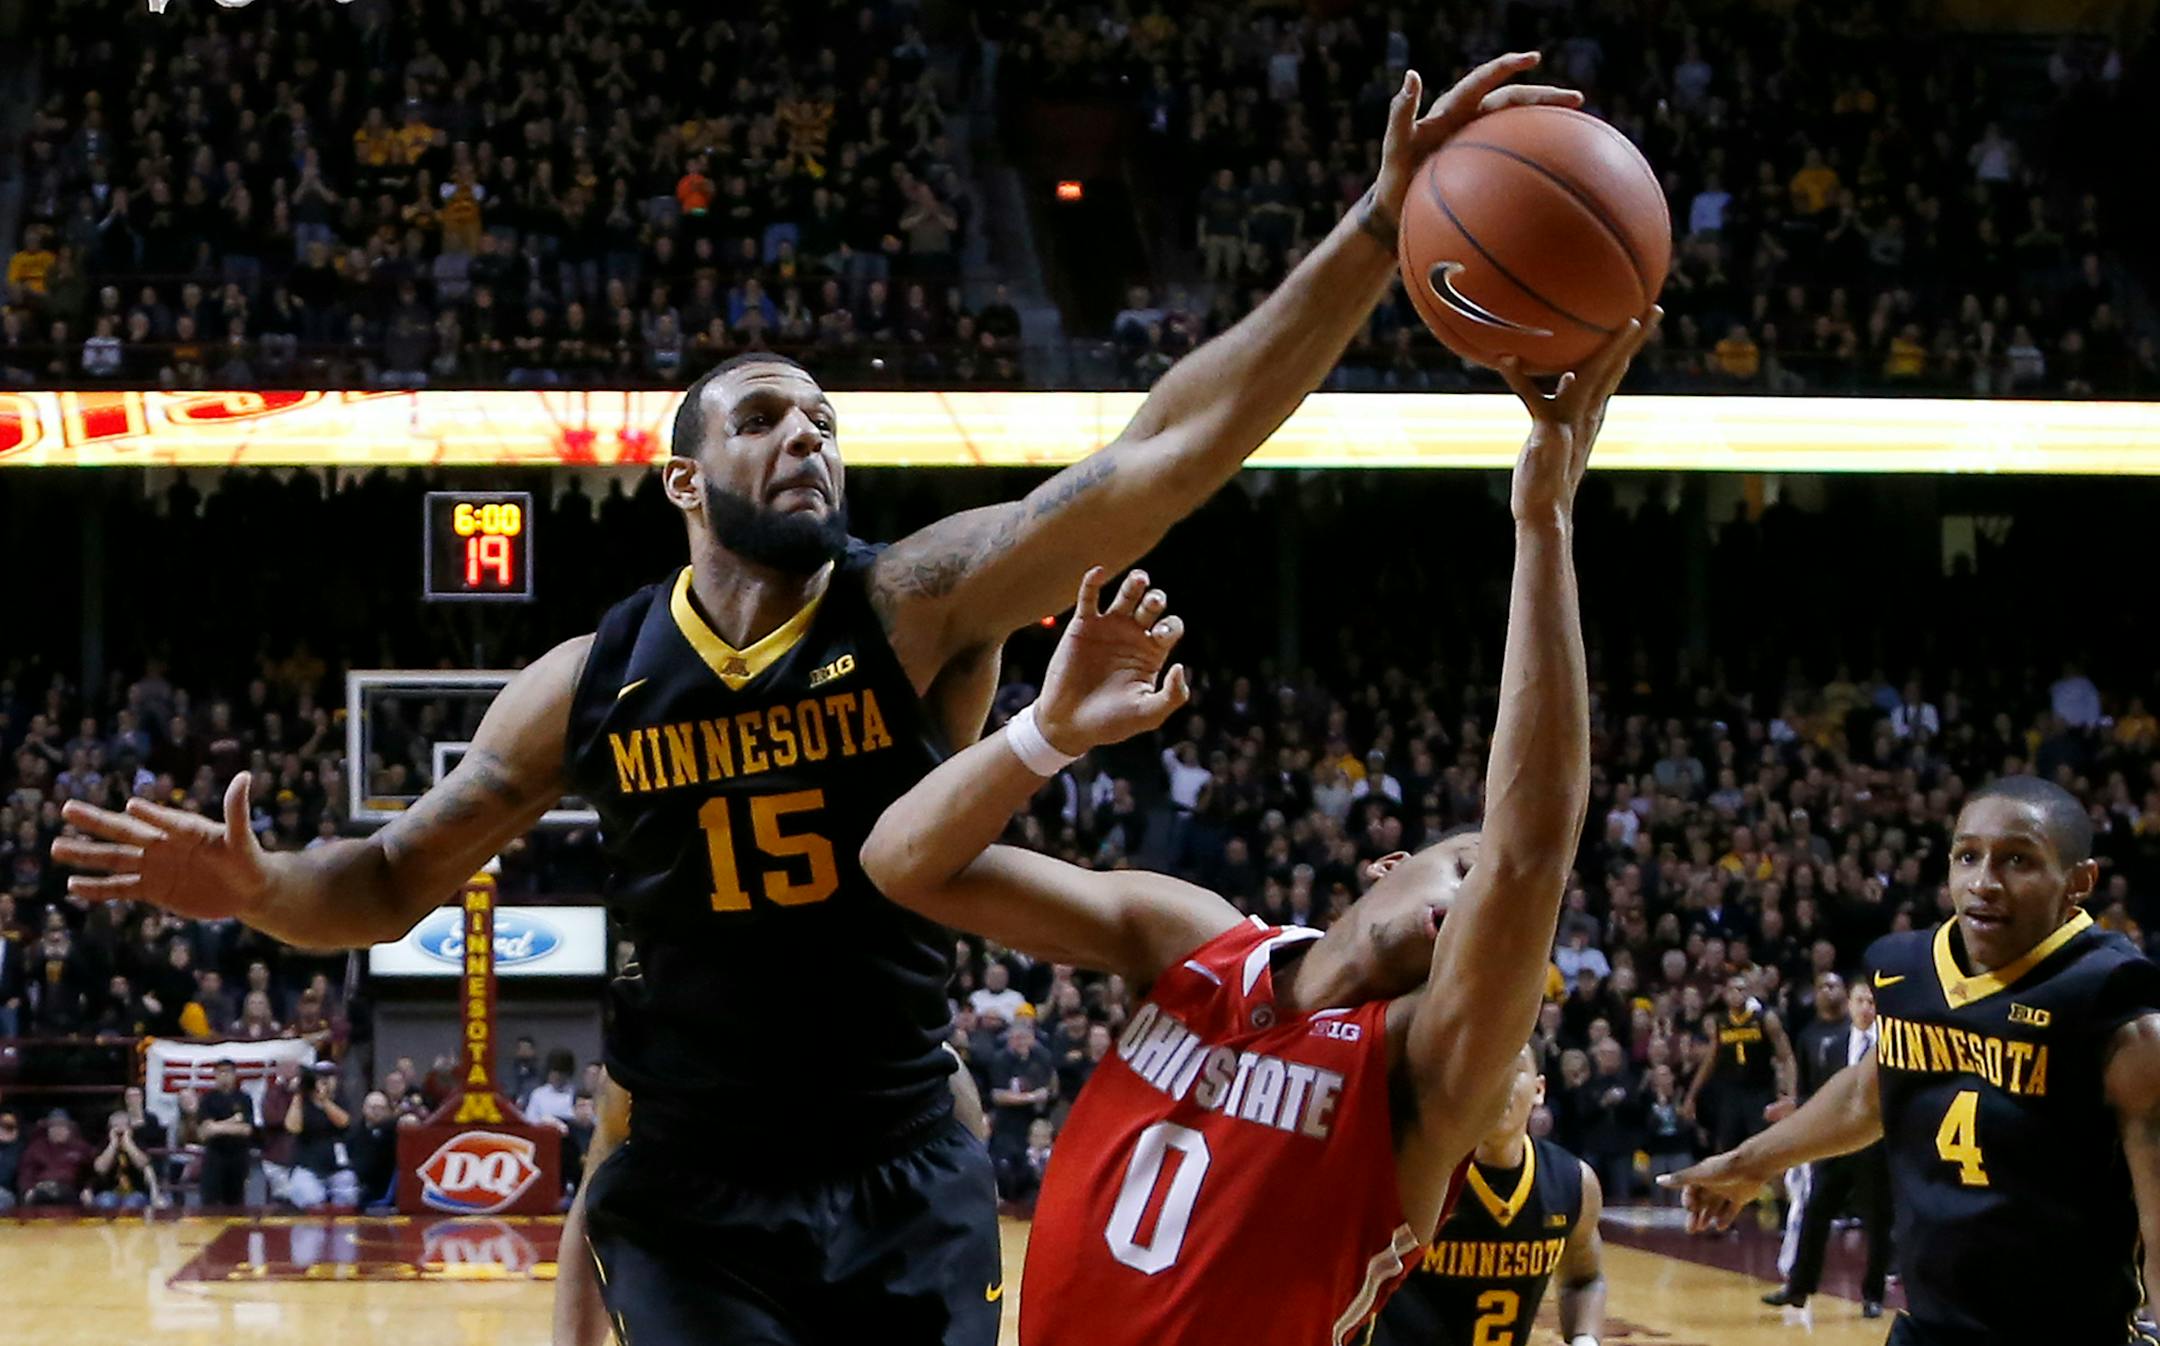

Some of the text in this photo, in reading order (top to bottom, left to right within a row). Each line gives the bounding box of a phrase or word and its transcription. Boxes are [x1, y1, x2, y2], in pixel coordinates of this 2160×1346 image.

[454, 503, 521, 536] 6:00
[467, 535, 511, 587] 19
[609, 688, 893, 793] MINNESOTA
[698, 789, 839, 912] 15
[465, 891, 490, 1084] MINNESOTA
[1117, 1002, 1345, 1140] OHIO STATE
[1877, 1014, 2049, 1096] MINNESOTA
[440, 1151, 521, 1197] DQ
[1935, 1090, 1990, 1186] 4
[1104, 1120, 1211, 1276] 0
[1473, 1289, 1520, 1346] 2
